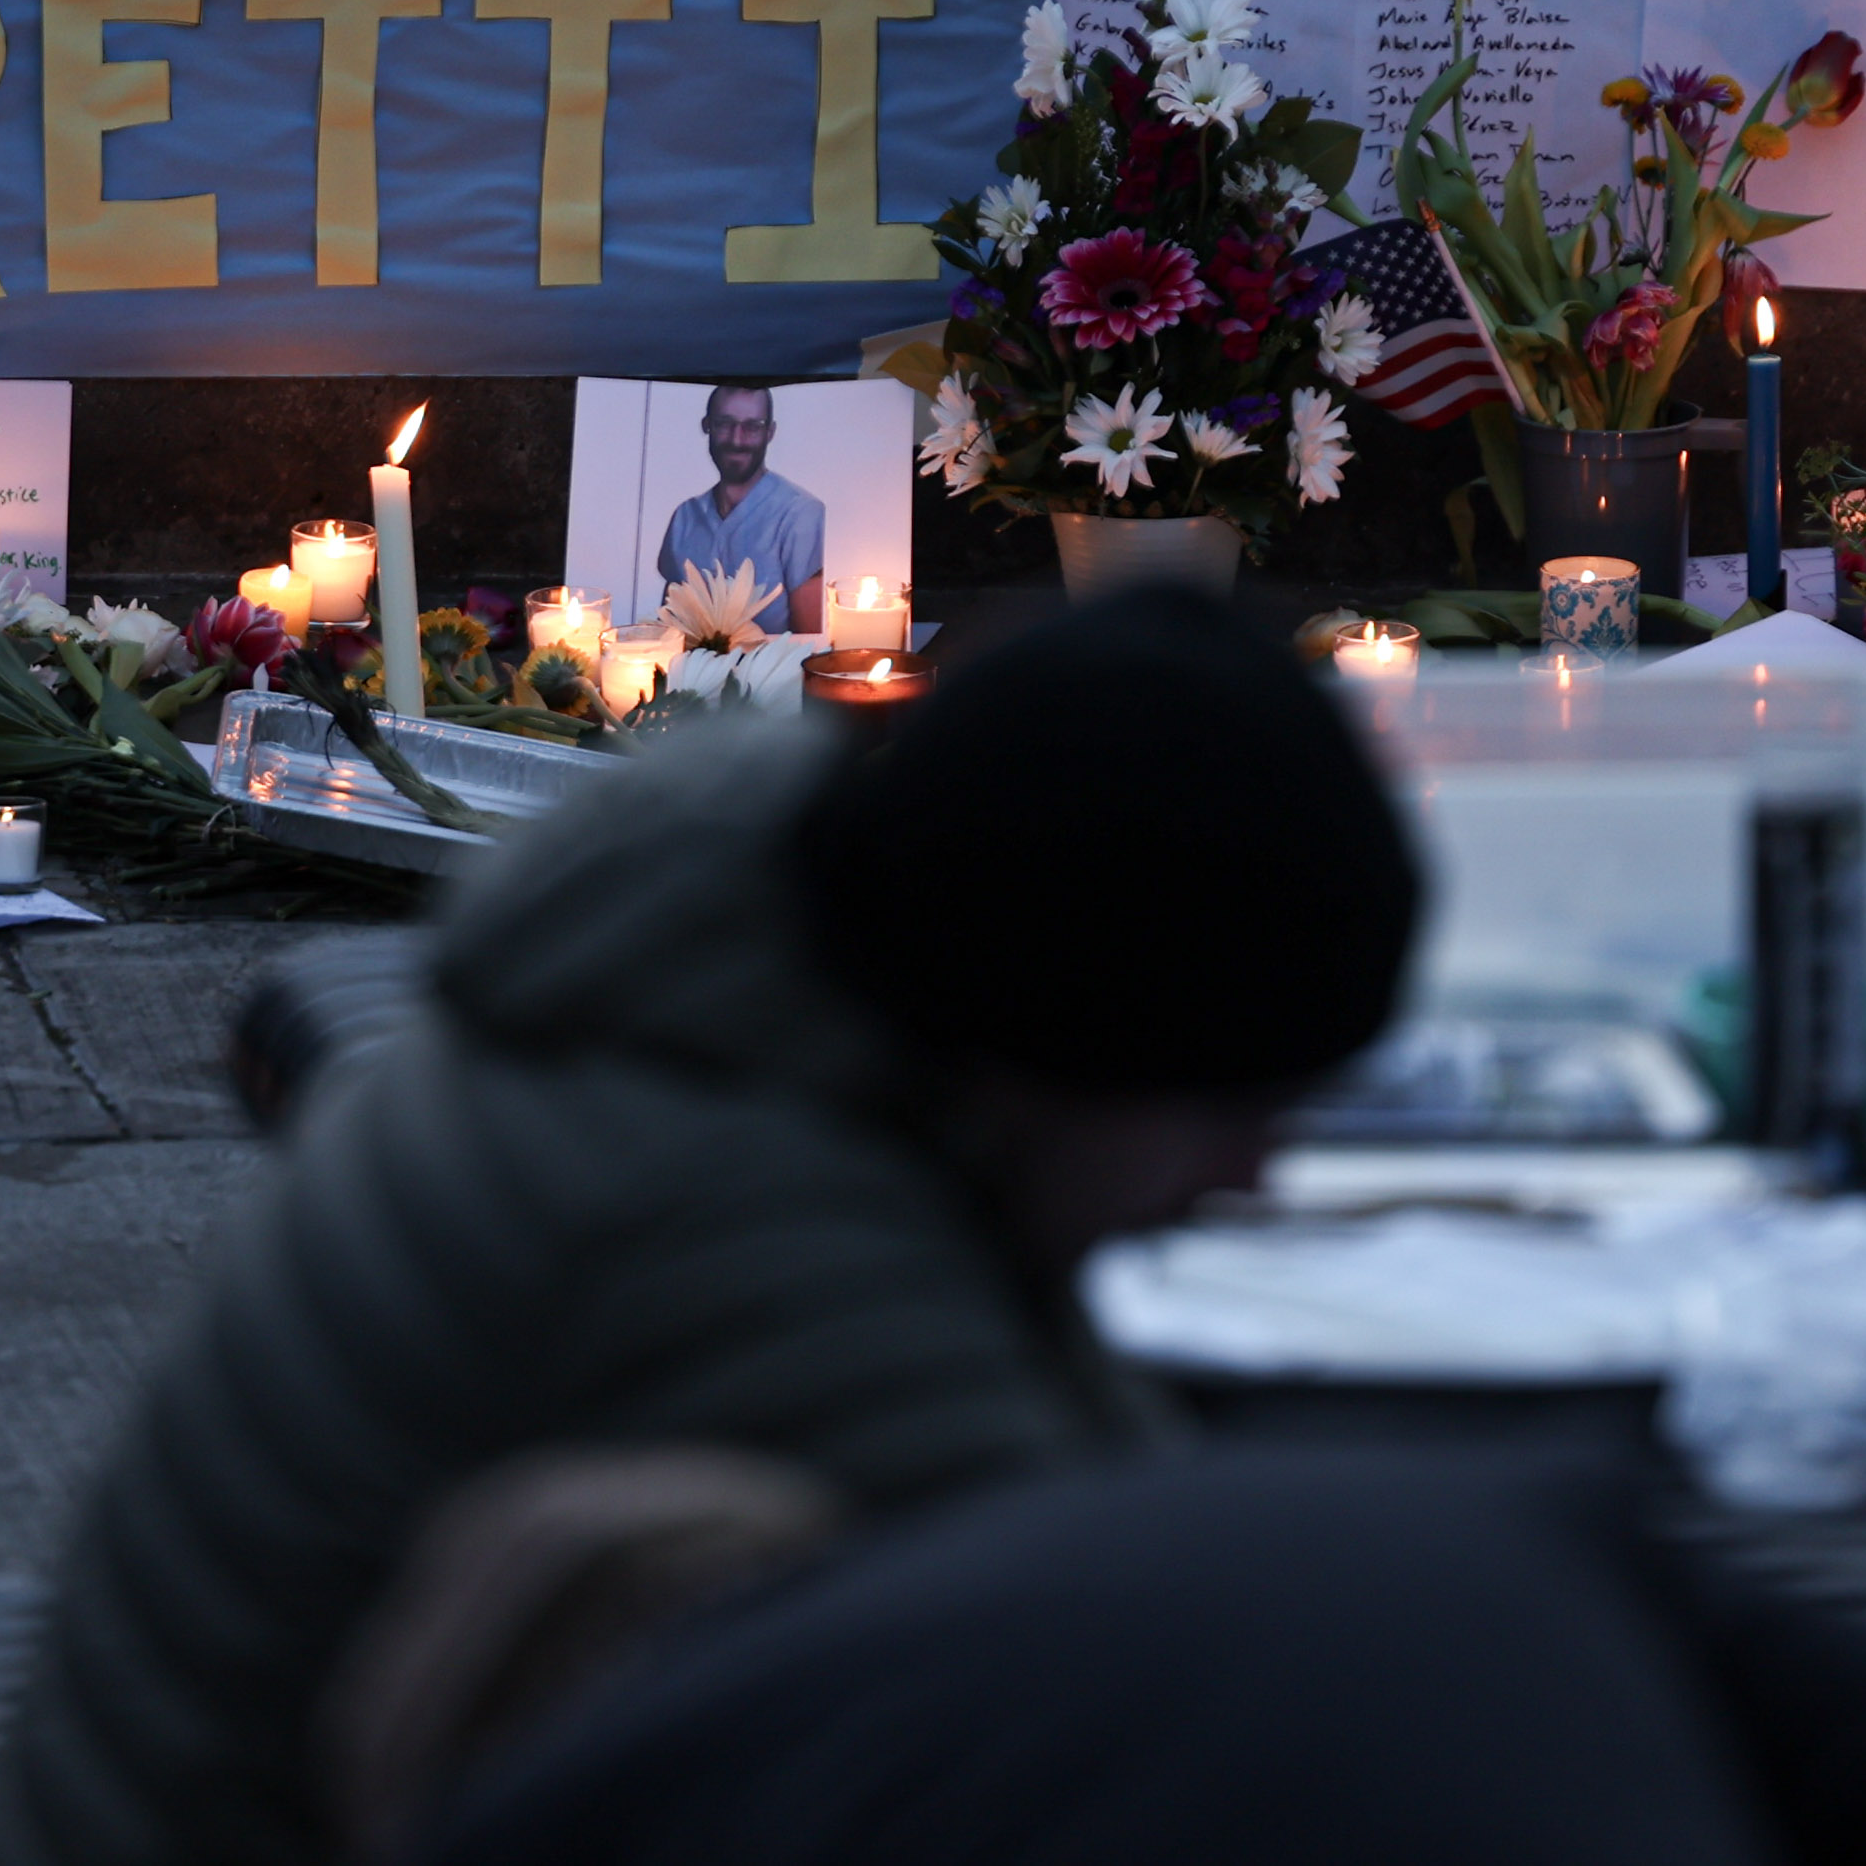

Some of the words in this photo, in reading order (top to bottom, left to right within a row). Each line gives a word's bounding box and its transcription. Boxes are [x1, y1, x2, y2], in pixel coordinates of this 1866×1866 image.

[1378, 8, 1429, 26] Marie
[1504, 8, 1570, 25] Blaise
[1369, 62, 1425, 79] Jesus
